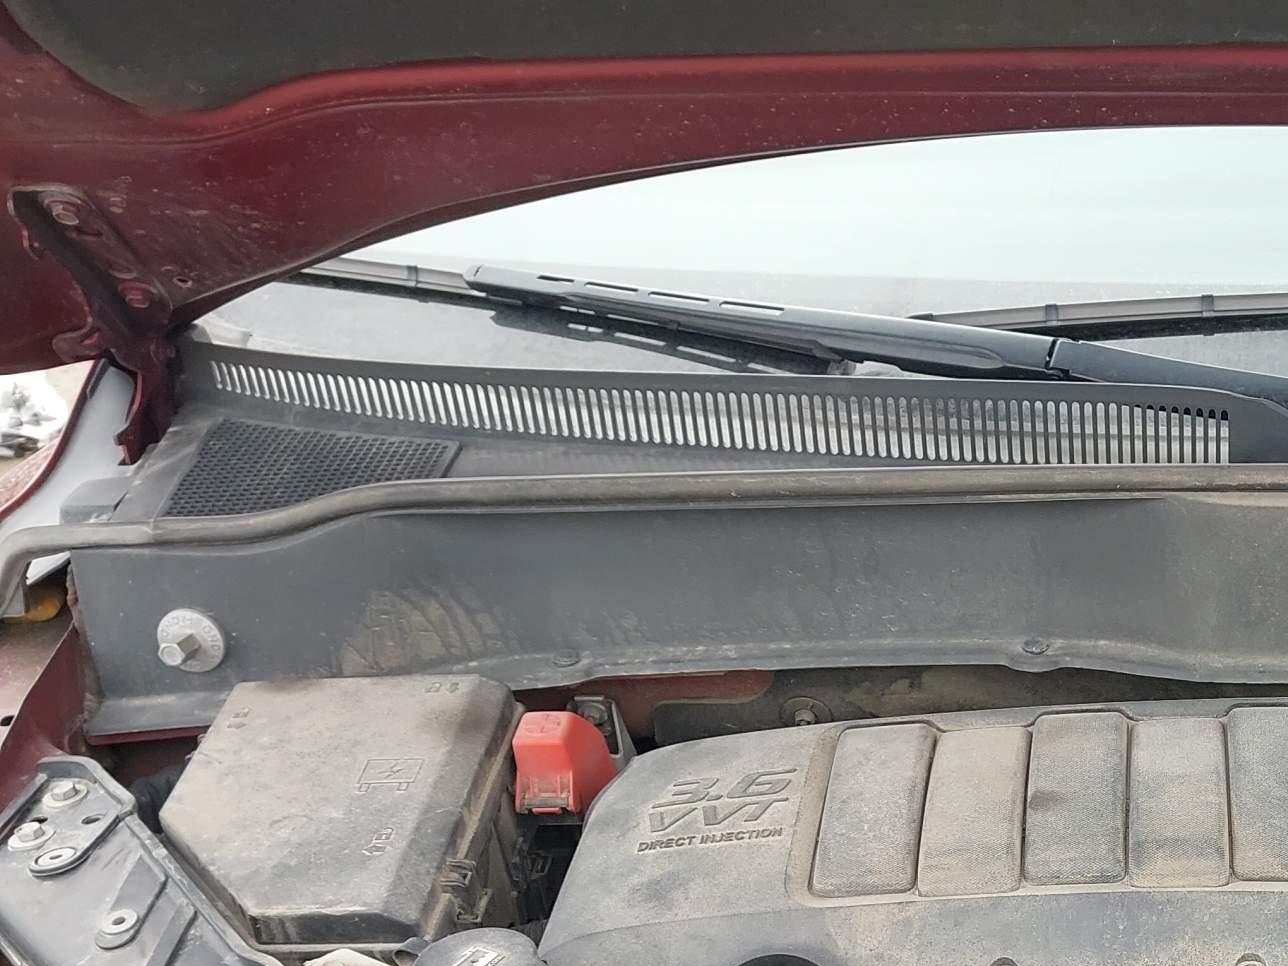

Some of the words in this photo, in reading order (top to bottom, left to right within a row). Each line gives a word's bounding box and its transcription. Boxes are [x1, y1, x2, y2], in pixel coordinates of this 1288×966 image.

[651, 767, 798, 809] 3.6
[648, 797, 790, 833] VVT
[637, 835, 696, 853] DIRECT
[700, 826, 784, 845] INJECTION
